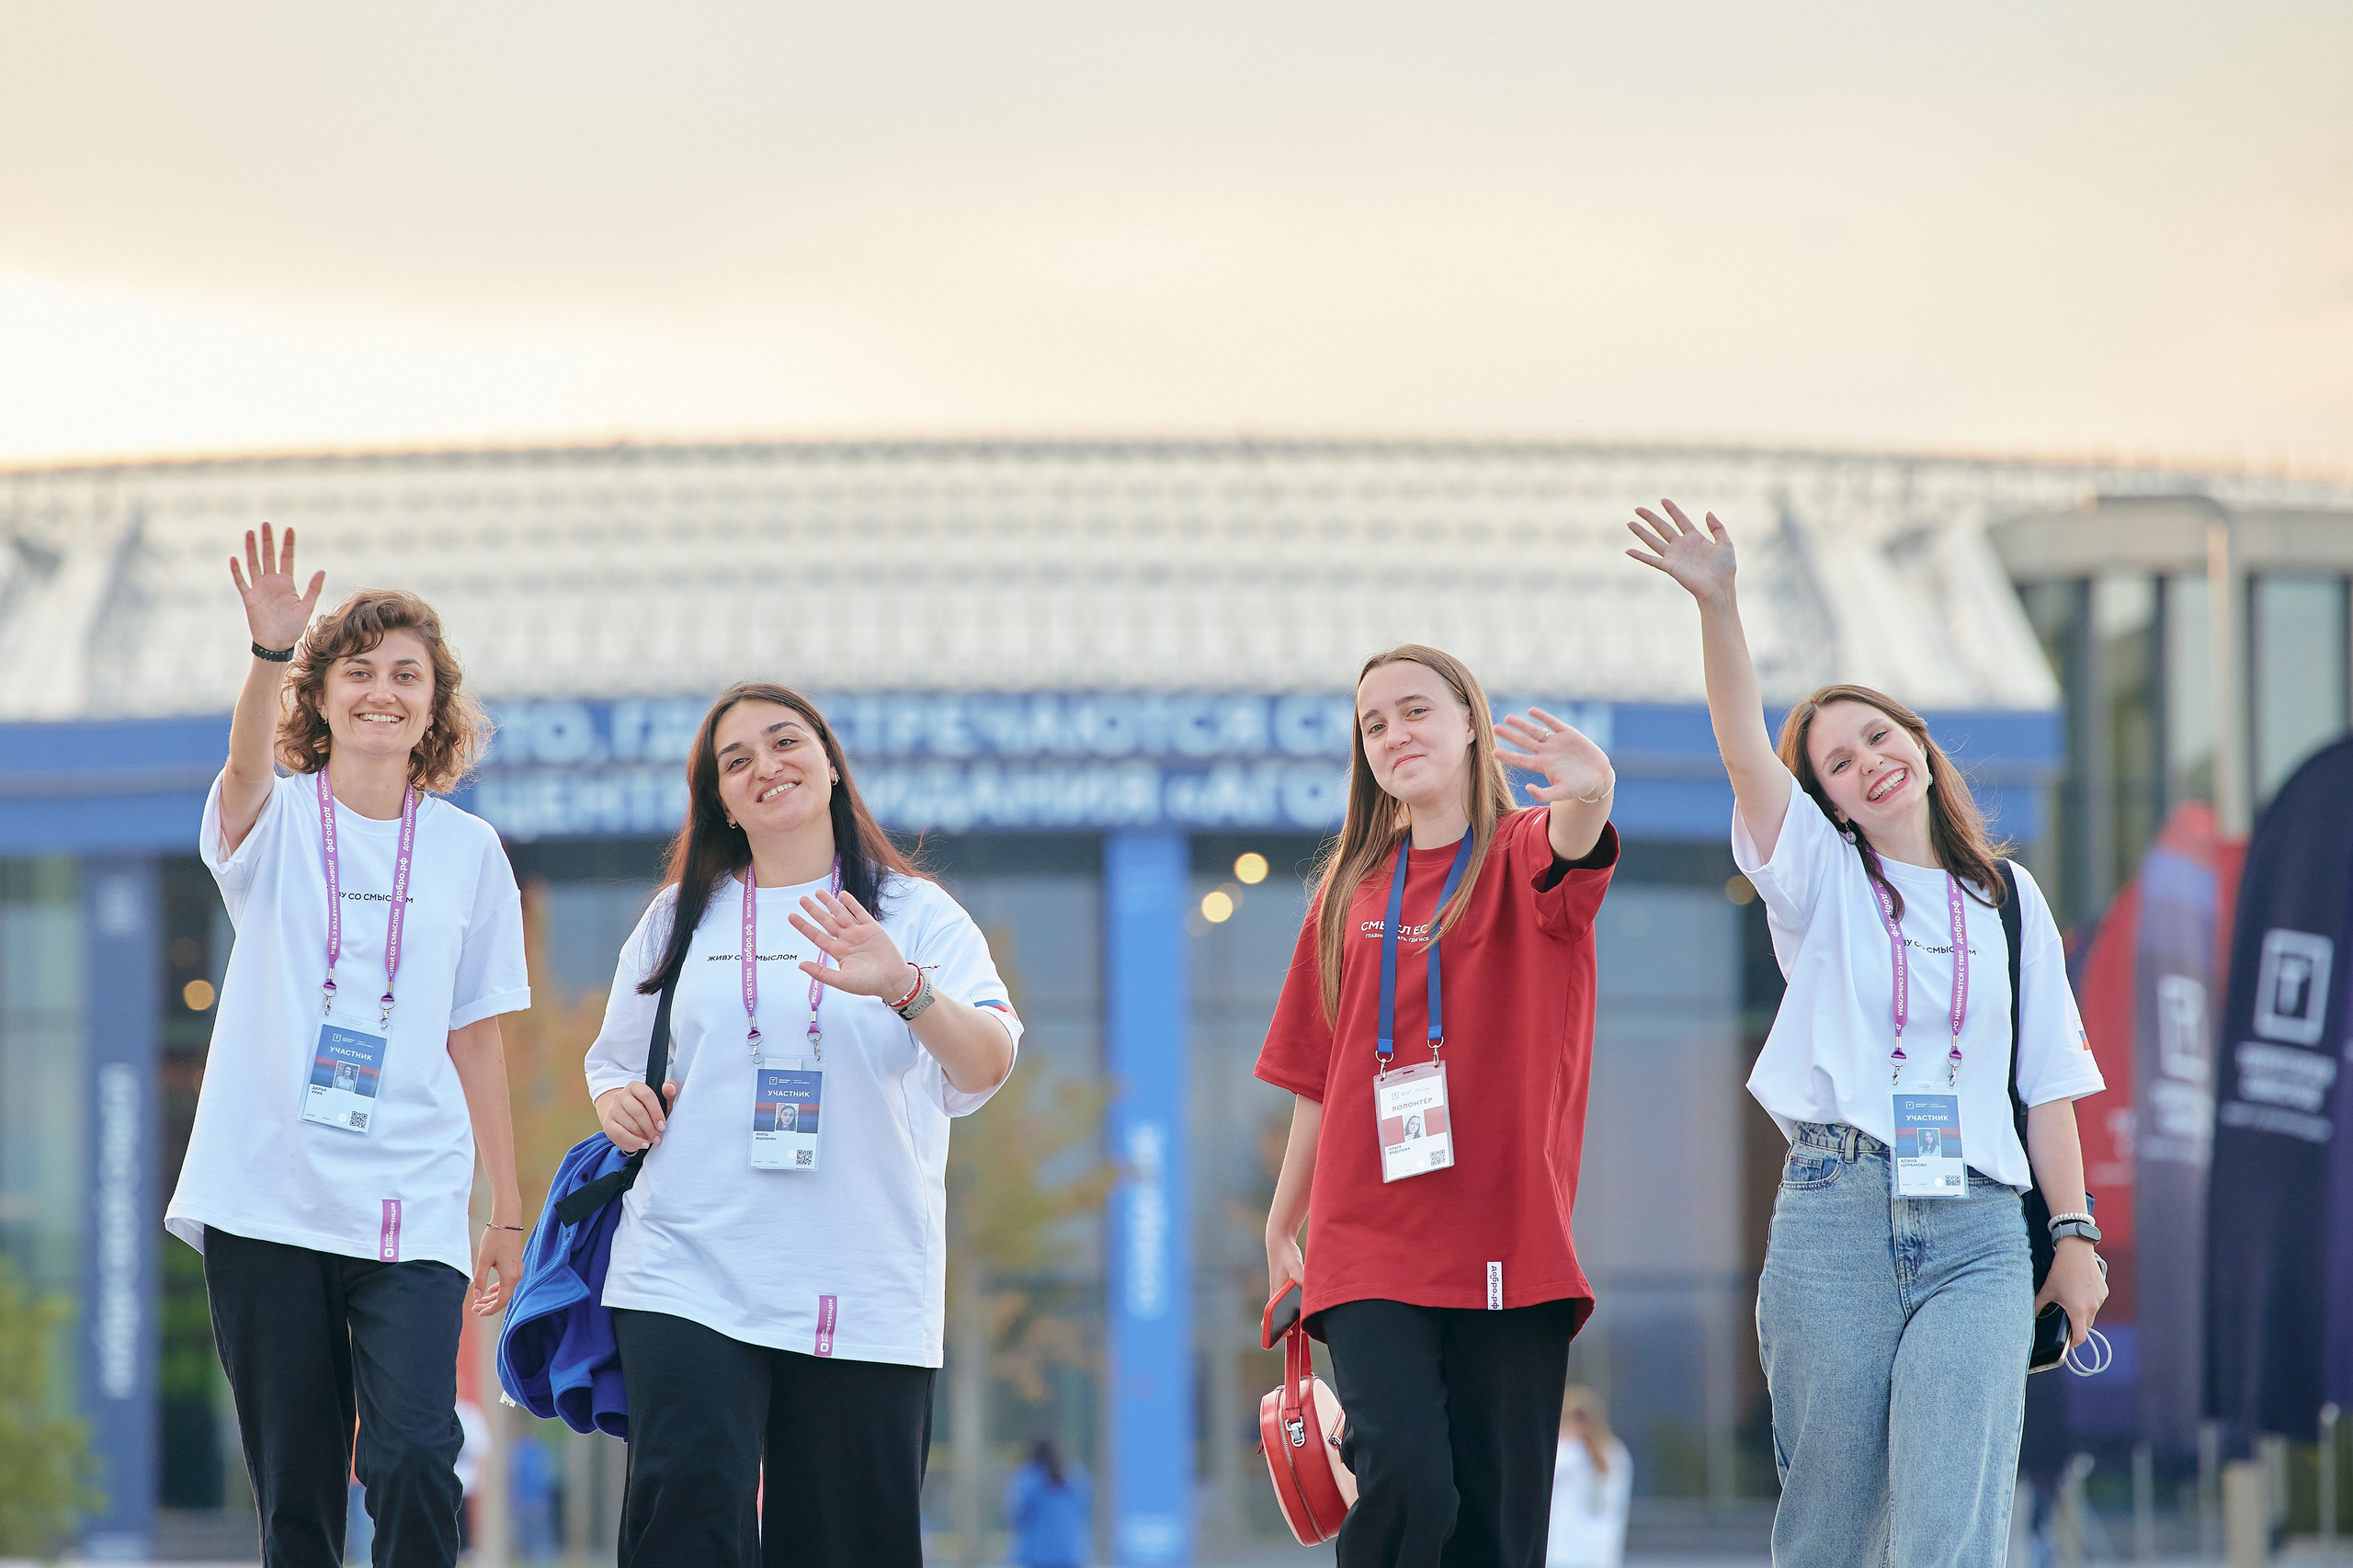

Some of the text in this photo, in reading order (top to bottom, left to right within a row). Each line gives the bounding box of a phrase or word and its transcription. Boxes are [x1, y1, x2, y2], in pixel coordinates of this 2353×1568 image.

[323, 806, 335, 853] добро.рф
[403, 827, 411, 852] ДОБРО
[327, 859, 335, 883] ДОБРО
[395, 857, 409, 903] добро.рф
[330, 885, 338, 930] НАЧИНАЕТСЯ
[347, 892, 414, 903] СО СМЫСМ
[391, 908, 400, 945] СМЫСЛОМ
[1951, 900, 1964, 945] добро.рф
[390, 946, 396, 956] СО
[744, 924, 754, 963] добро.рф
[1895, 943, 1904, 965] ЖИВИ
[1926, 946, 1977, 956] СМЫСМ
[707, 954, 733, 962] ЖИВУ
[755, 953, 798, 961] МЫСЛОМ
[1898, 966, 1904, 976] СО
[1954, 972, 1964, 1020] НАЧИНАЕТСЯ
[329, 1046, 373, 1062] УЧАСТНИК
[767, 1089, 810, 1097] УЧАСТНИК
[1392, 1096, 1433, 1112] ВОЛОНТЁР
[1491, 1265, 1499, 1310] добро.рф
